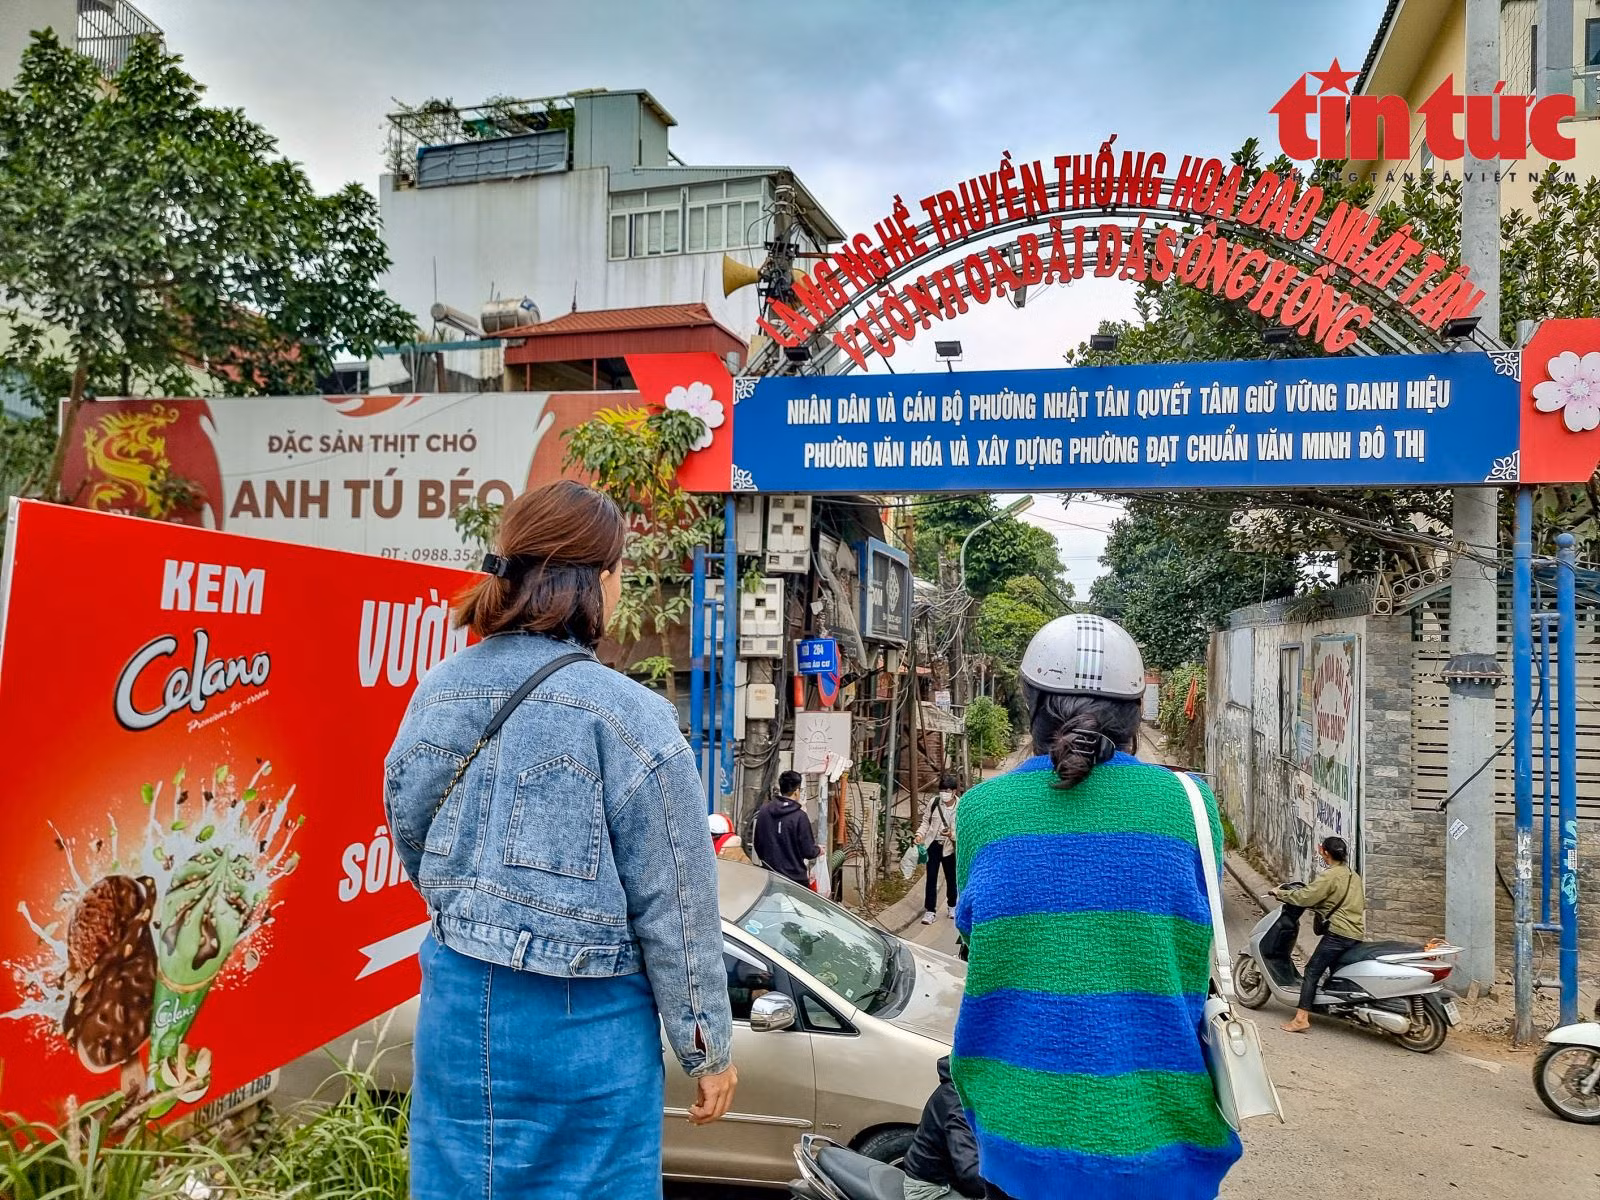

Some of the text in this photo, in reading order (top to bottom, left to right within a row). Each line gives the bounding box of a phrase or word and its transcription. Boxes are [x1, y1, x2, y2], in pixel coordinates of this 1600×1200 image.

[831, 194, 929, 293] NGHỀ
[919, 150, 1049, 247] TRUYỀN
[1054, 134, 1168, 211] THỐNG
[1168, 154, 1245, 221] HOA
[1314, 200, 1425, 290] NHẬT
[1398, 253, 1487, 331] TÂN
[833, 275, 943, 373] VƯỜN
[931, 245, 1024, 317] HOA
[1093, 212, 1149, 282] ĐÁ
[1151, 221, 1268, 300] SÔNG
[1247, 262, 1374, 353] HỒNG
[787, 375, 1451, 427] NHÂN DÂN VÀ CÁN BỘ PHƯỜNG NHẬT TÂN QUYẾT TÂM GIỮ VỮNG DANH HIỆU
[268, 427, 478, 459] ĐẶC SẢN THỊT CHÓ
[804, 424, 1426, 471] PHƯỜNG VĂN HÓA VÀ XÂY DỰNG PHƯỜNG ĐẠT CHUẨN VĂN MINH ĐÔ THỊ
[230, 467, 514, 520] ANH TÚ BÉO
[160, 559, 266, 615] KEM
[114, 628, 271, 731] Celano
